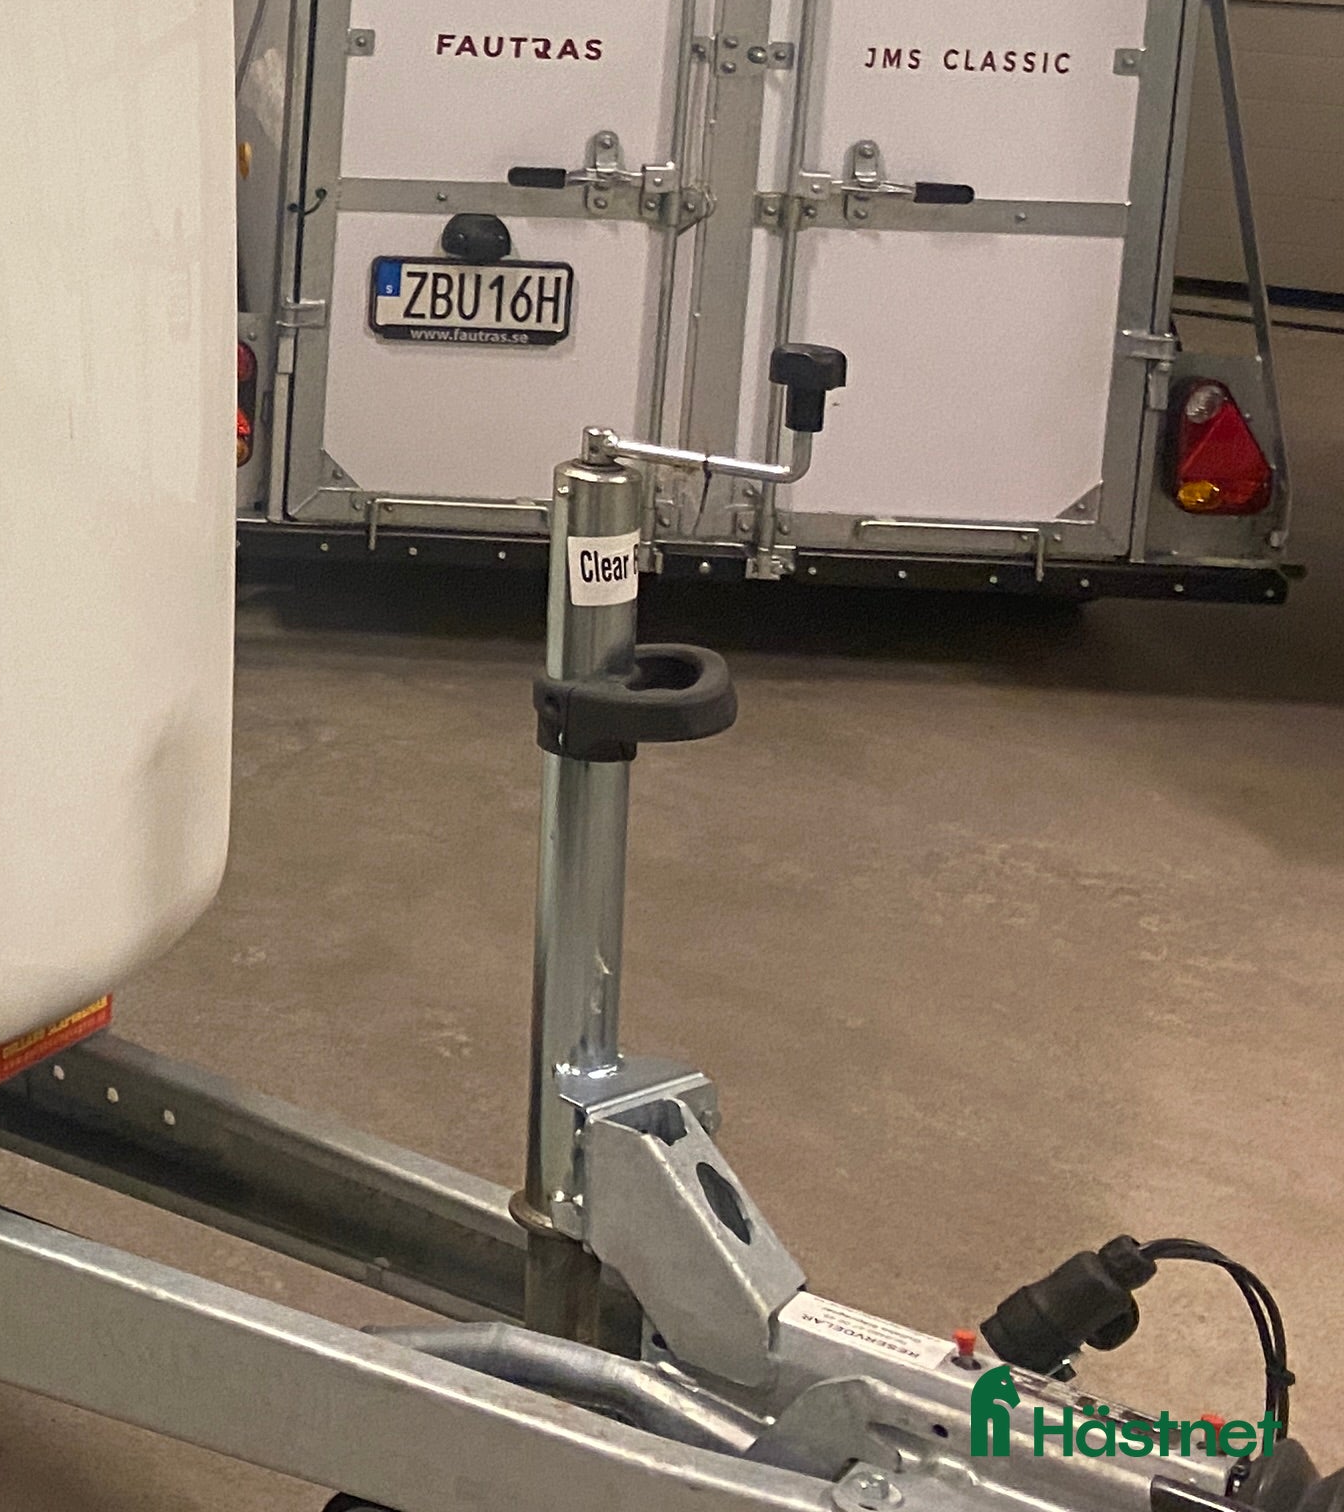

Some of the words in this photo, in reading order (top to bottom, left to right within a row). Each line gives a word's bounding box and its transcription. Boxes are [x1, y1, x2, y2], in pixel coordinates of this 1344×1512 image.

[436, 33, 603, 60] FAUTRAS
[864, 47, 921, 70] JMS
[943, 48, 1071, 74] CLASSIC
[385, 284, 394, 294] S
[410, 328, 529, 344] www.fautras.se
[580, 550, 629, 583] Clear
